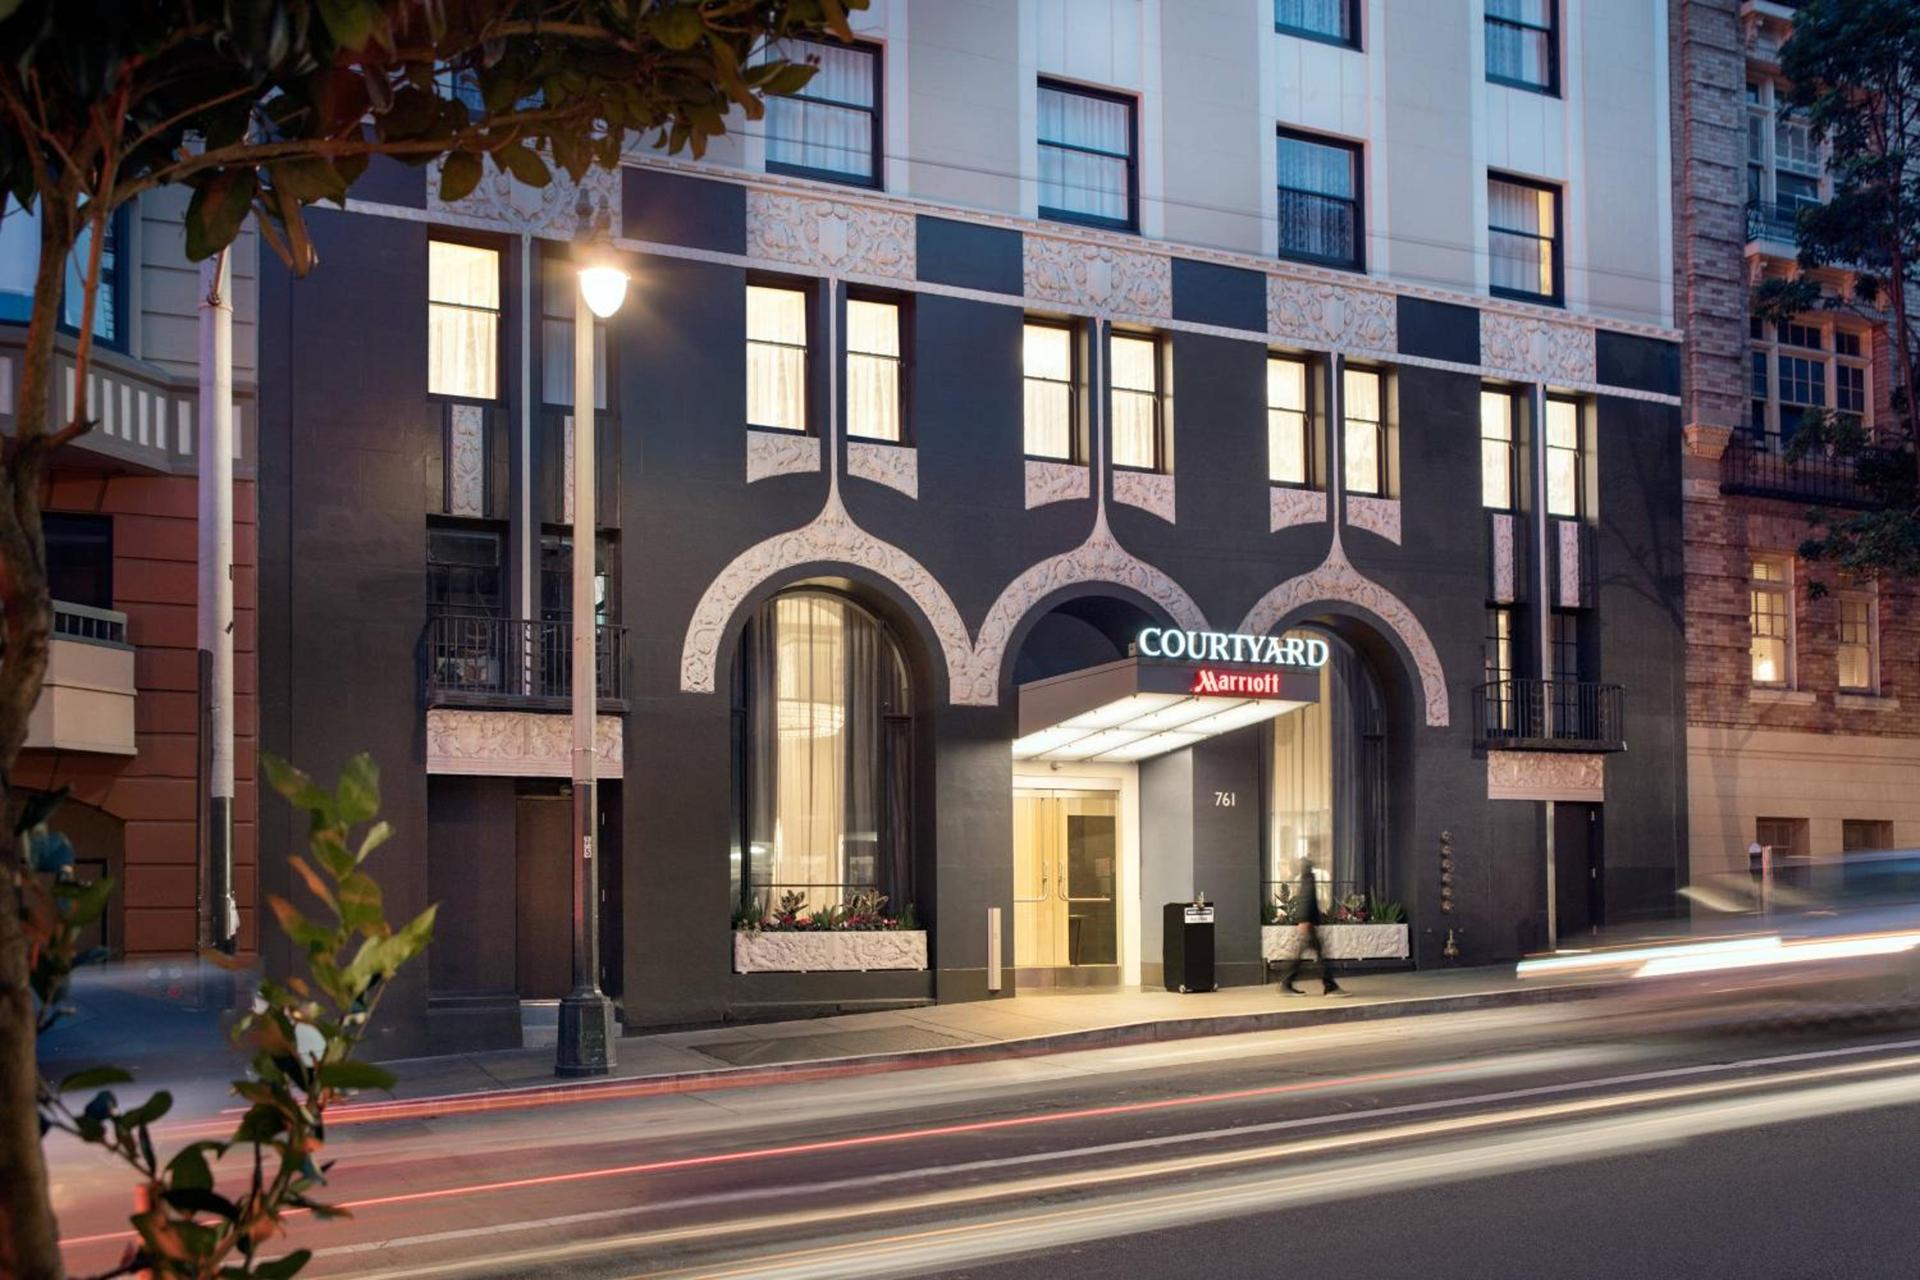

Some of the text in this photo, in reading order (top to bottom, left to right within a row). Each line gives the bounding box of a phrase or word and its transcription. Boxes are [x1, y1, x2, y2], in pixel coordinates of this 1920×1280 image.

[1139, 628, 1329, 667] COURTYARD
[1194, 670, 1280, 693] Marriott
[1214, 791, 1236, 807] 761
